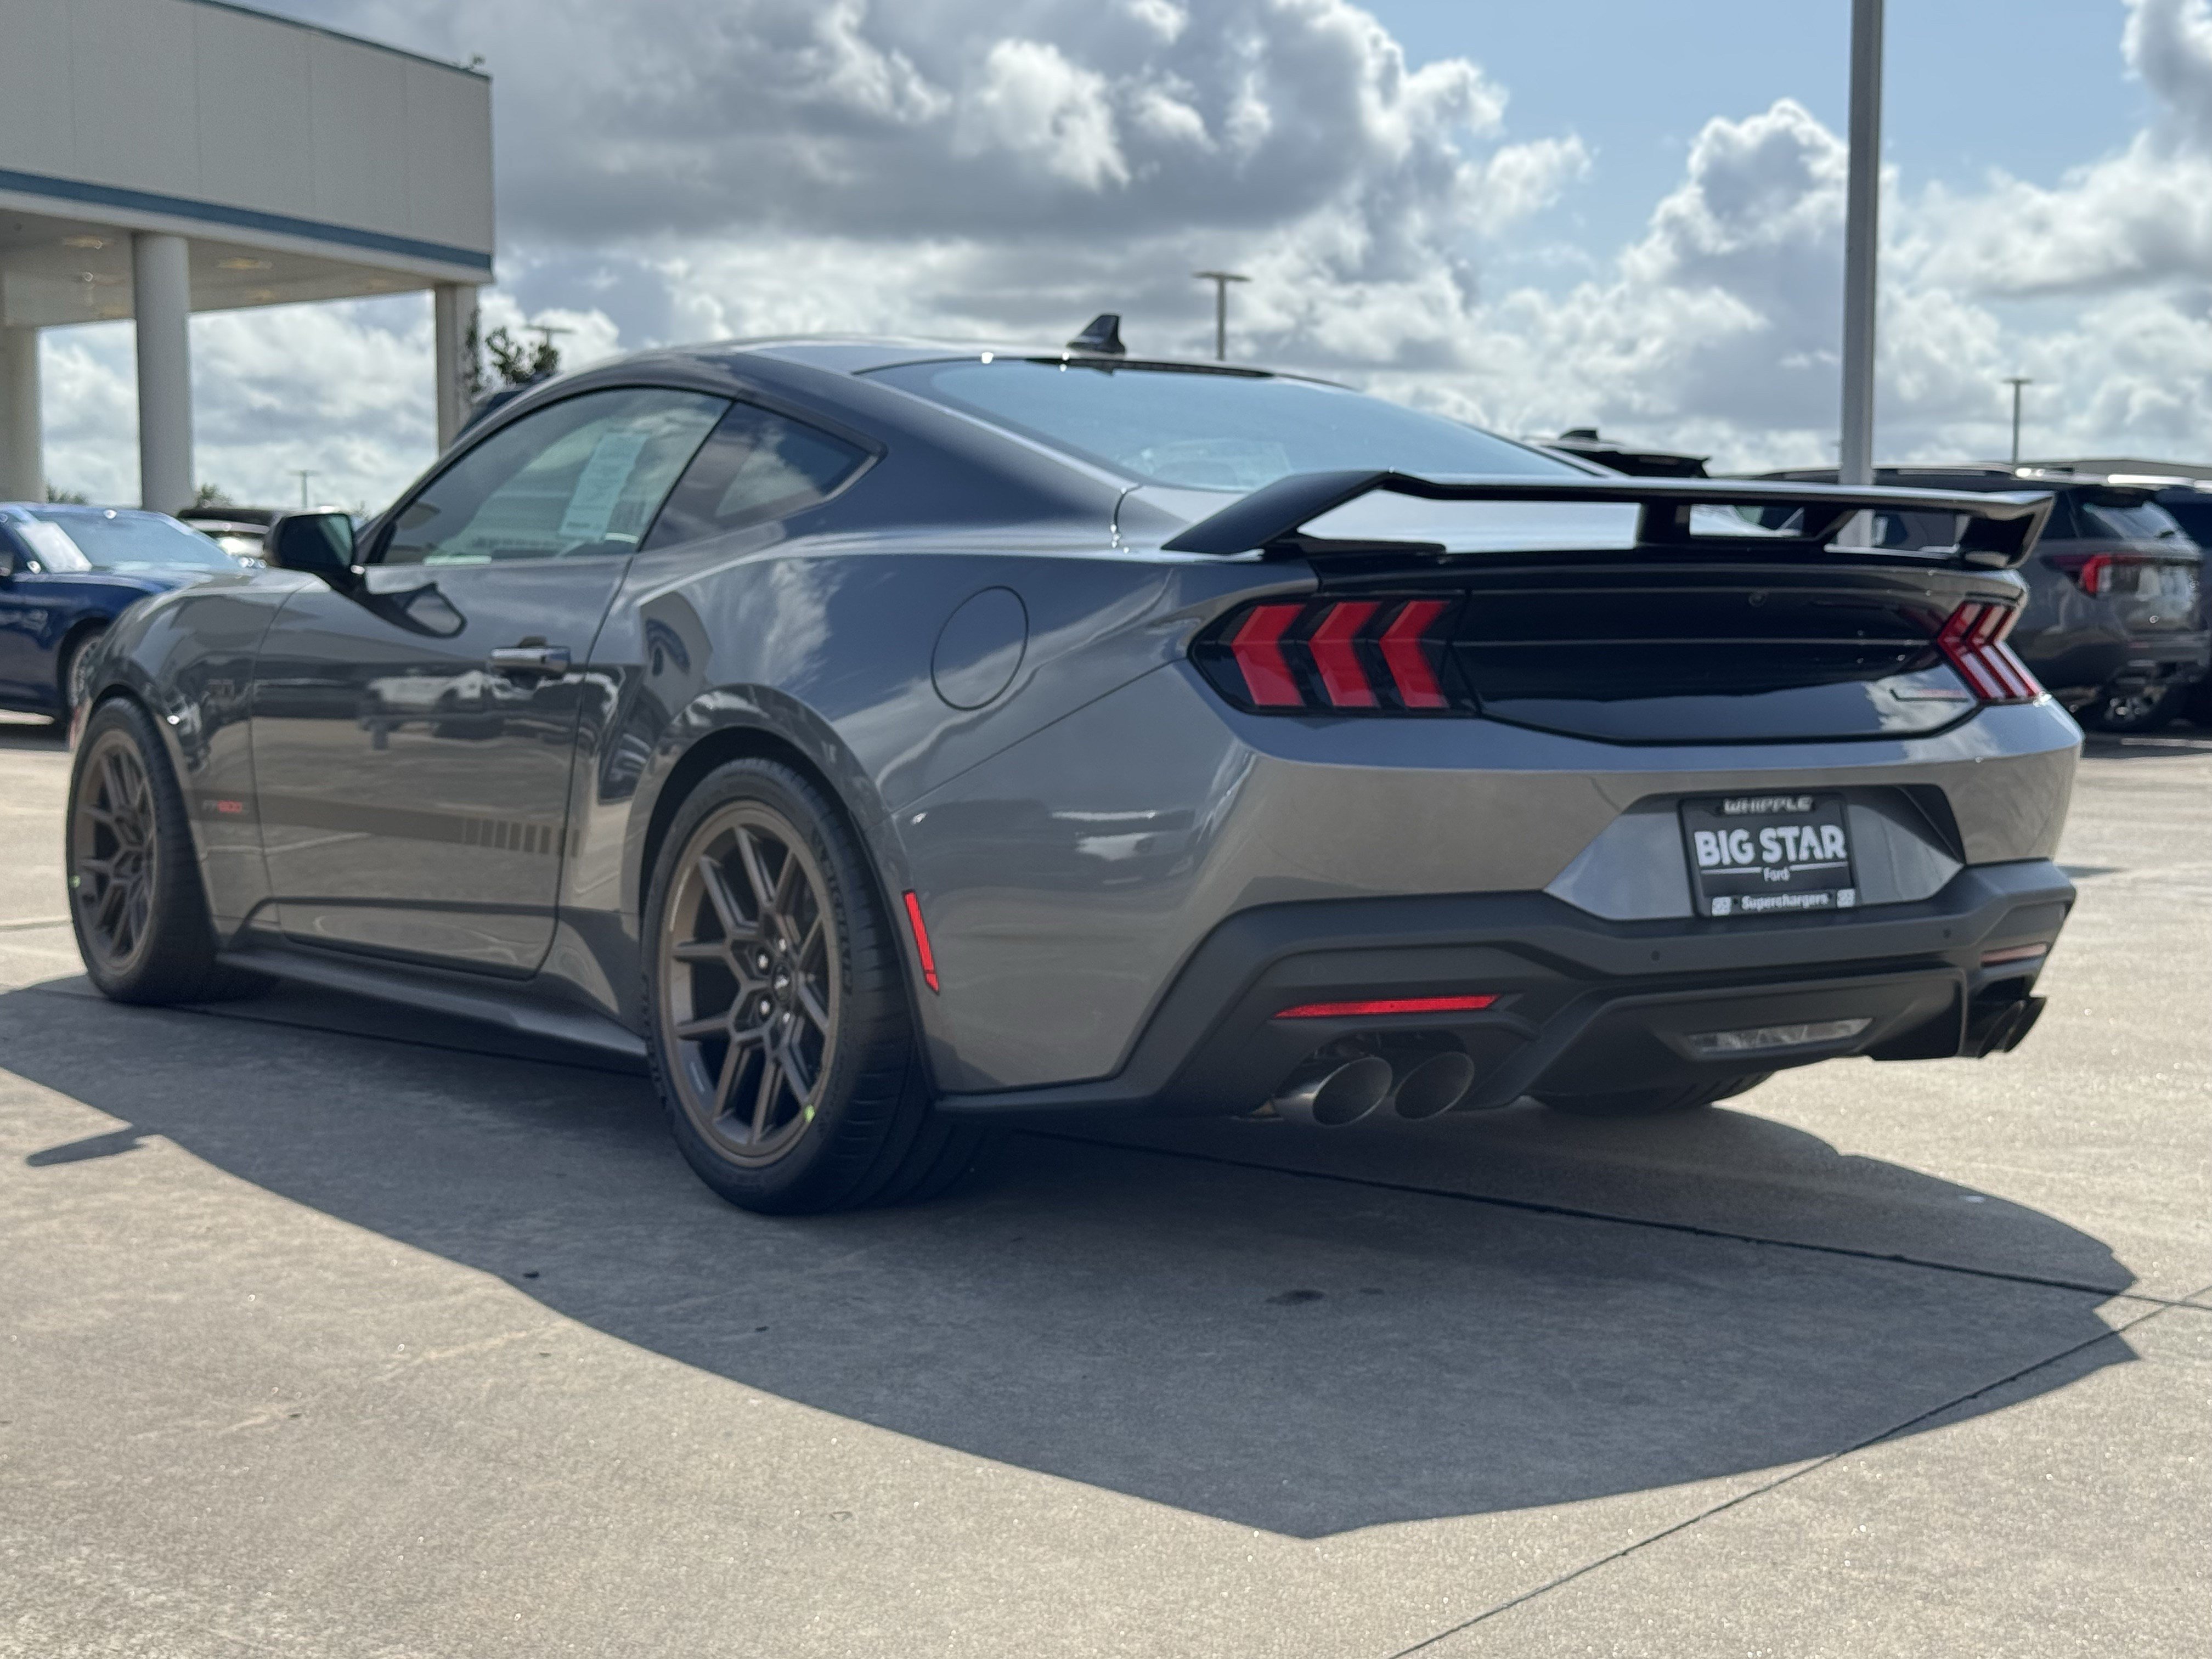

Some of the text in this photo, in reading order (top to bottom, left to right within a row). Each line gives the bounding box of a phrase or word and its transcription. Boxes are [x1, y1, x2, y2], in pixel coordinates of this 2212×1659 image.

[1694, 824, 1847, 867] BIG STAR
[1741, 893, 1829, 911] Superchargers
